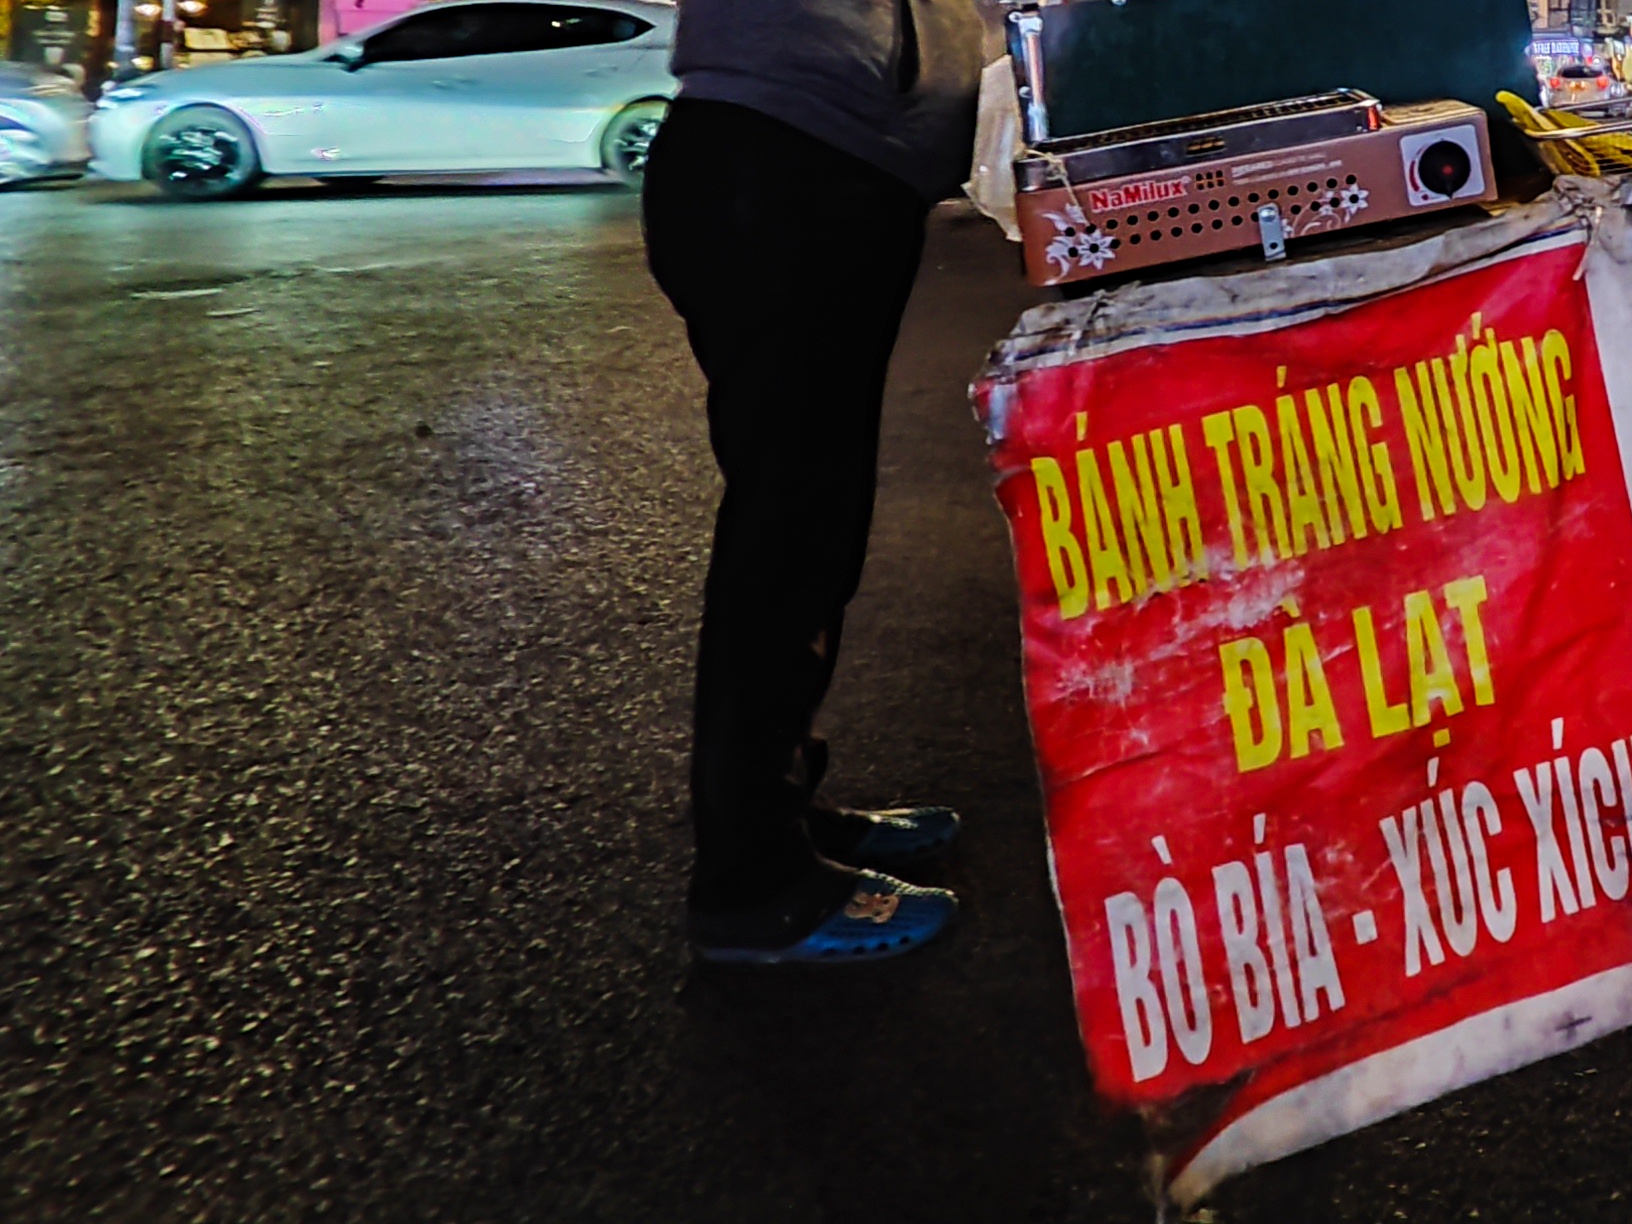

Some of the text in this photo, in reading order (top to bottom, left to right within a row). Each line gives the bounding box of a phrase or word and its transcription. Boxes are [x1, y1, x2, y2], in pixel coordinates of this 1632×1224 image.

[1089, 179, 1187, 213] NaMilux
[1031, 311, 1586, 621] BÁNH TRÁNG NƯỚNG
[1219, 574, 1496, 773] ĐÀ LẠT
[1104, 835, 1212, 1083] BÒ
[1211, 812, 1346, 1045] BÍA
[1379, 756, 1518, 977] XÚC
